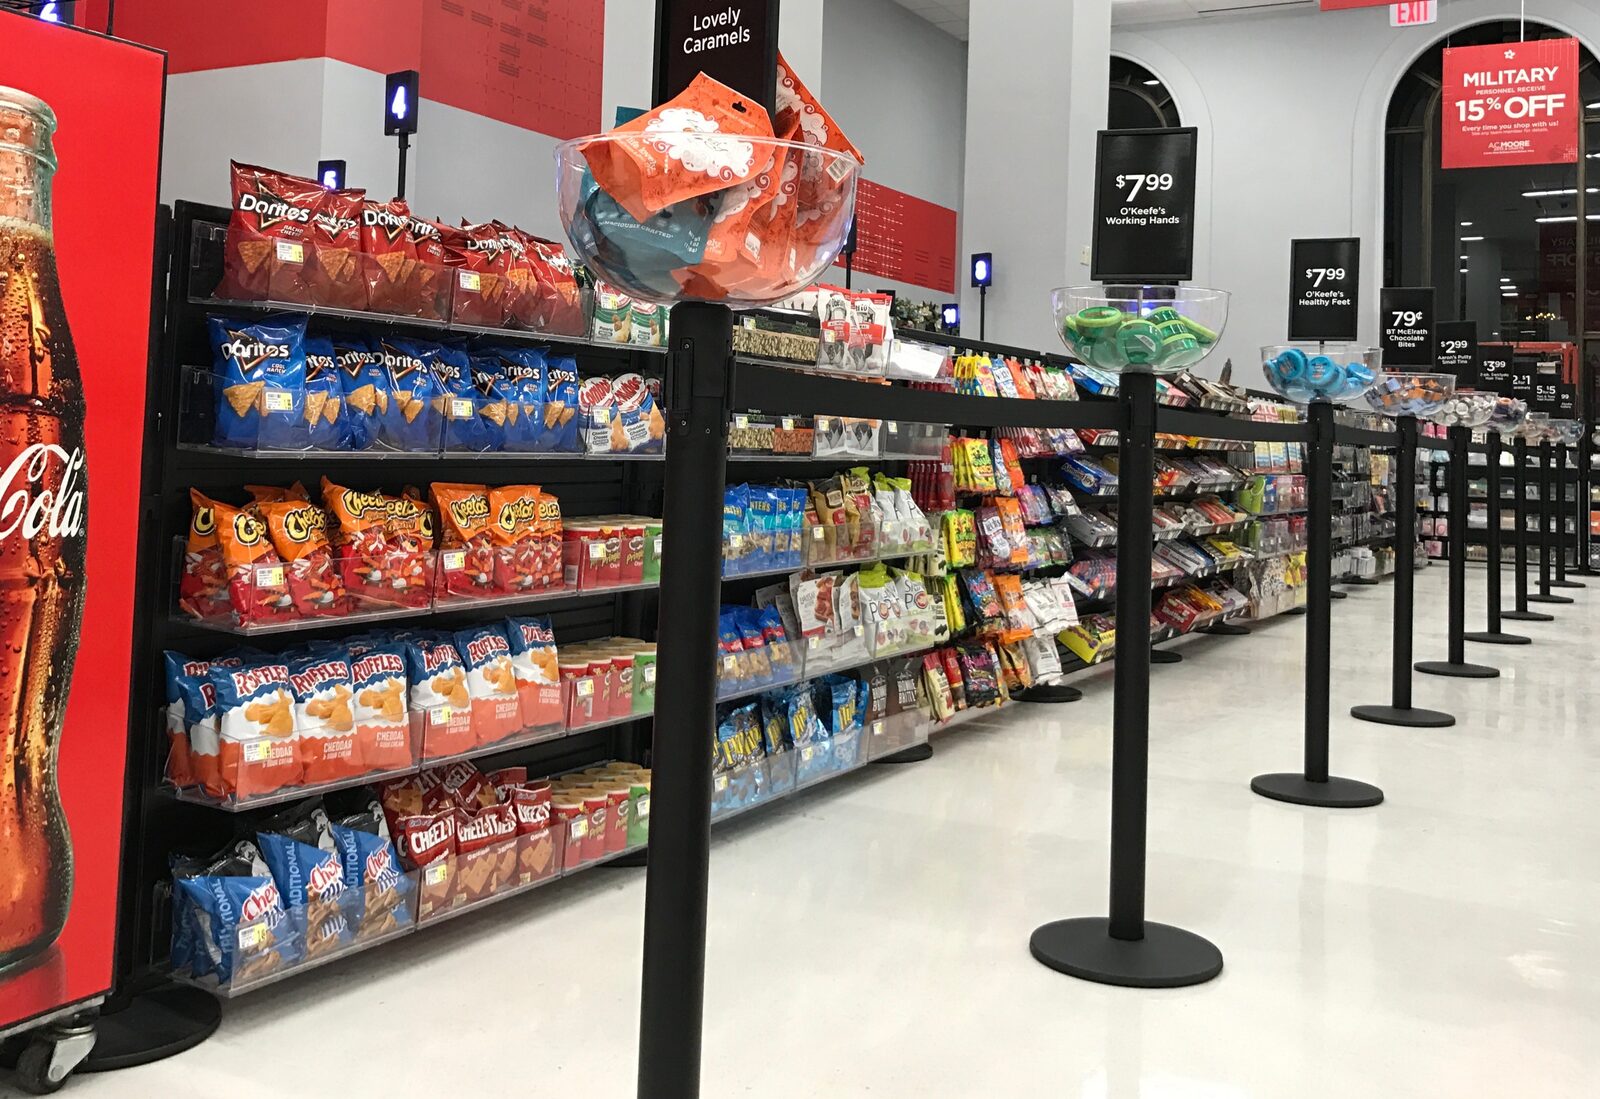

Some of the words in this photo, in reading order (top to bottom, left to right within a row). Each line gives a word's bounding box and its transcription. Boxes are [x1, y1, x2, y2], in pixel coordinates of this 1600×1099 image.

[693, 6, 741, 32] Lovely
[683, 26, 750, 54] Caramels
[1463, 66, 1559, 87] MILITARY
[392, 86, 406, 119] 4
[1475, 87, 1516, 95] PERSONNEL
[1455, 97, 1502, 122] 15%
[1503, 93, 1566, 119] OFF
[1499, 123, 1512, 131] you
[1513, 121, 1530, 130] shop
[1532, 120, 1547, 128] with
[239, 193, 310, 223] Doritos
[1105, 216, 1146, 226] Working
[1149, 215, 1180, 225] Hands
[1120, 206, 1166, 215] O'Keefe's
[1299, 298, 1329, 307] Healthy
[1331, 298, 1350, 306] Feet
[1305, 290, 1344, 298] O'Keefe's
[221, 339, 289, 359] Doritos
[231, 664, 289, 698] RUFFLES
[290, 660, 350, 696] RUFFLES
[351, 653, 404, 684] RUFFLES
[323, 739, 352, 753] CHEDDAR
[311, 854, 342, 892] Chex
[367, 848, 391, 880] Chex
[285, 840, 305, 920] TRADITIONAL
[242, 882, 279, 921] Chex
